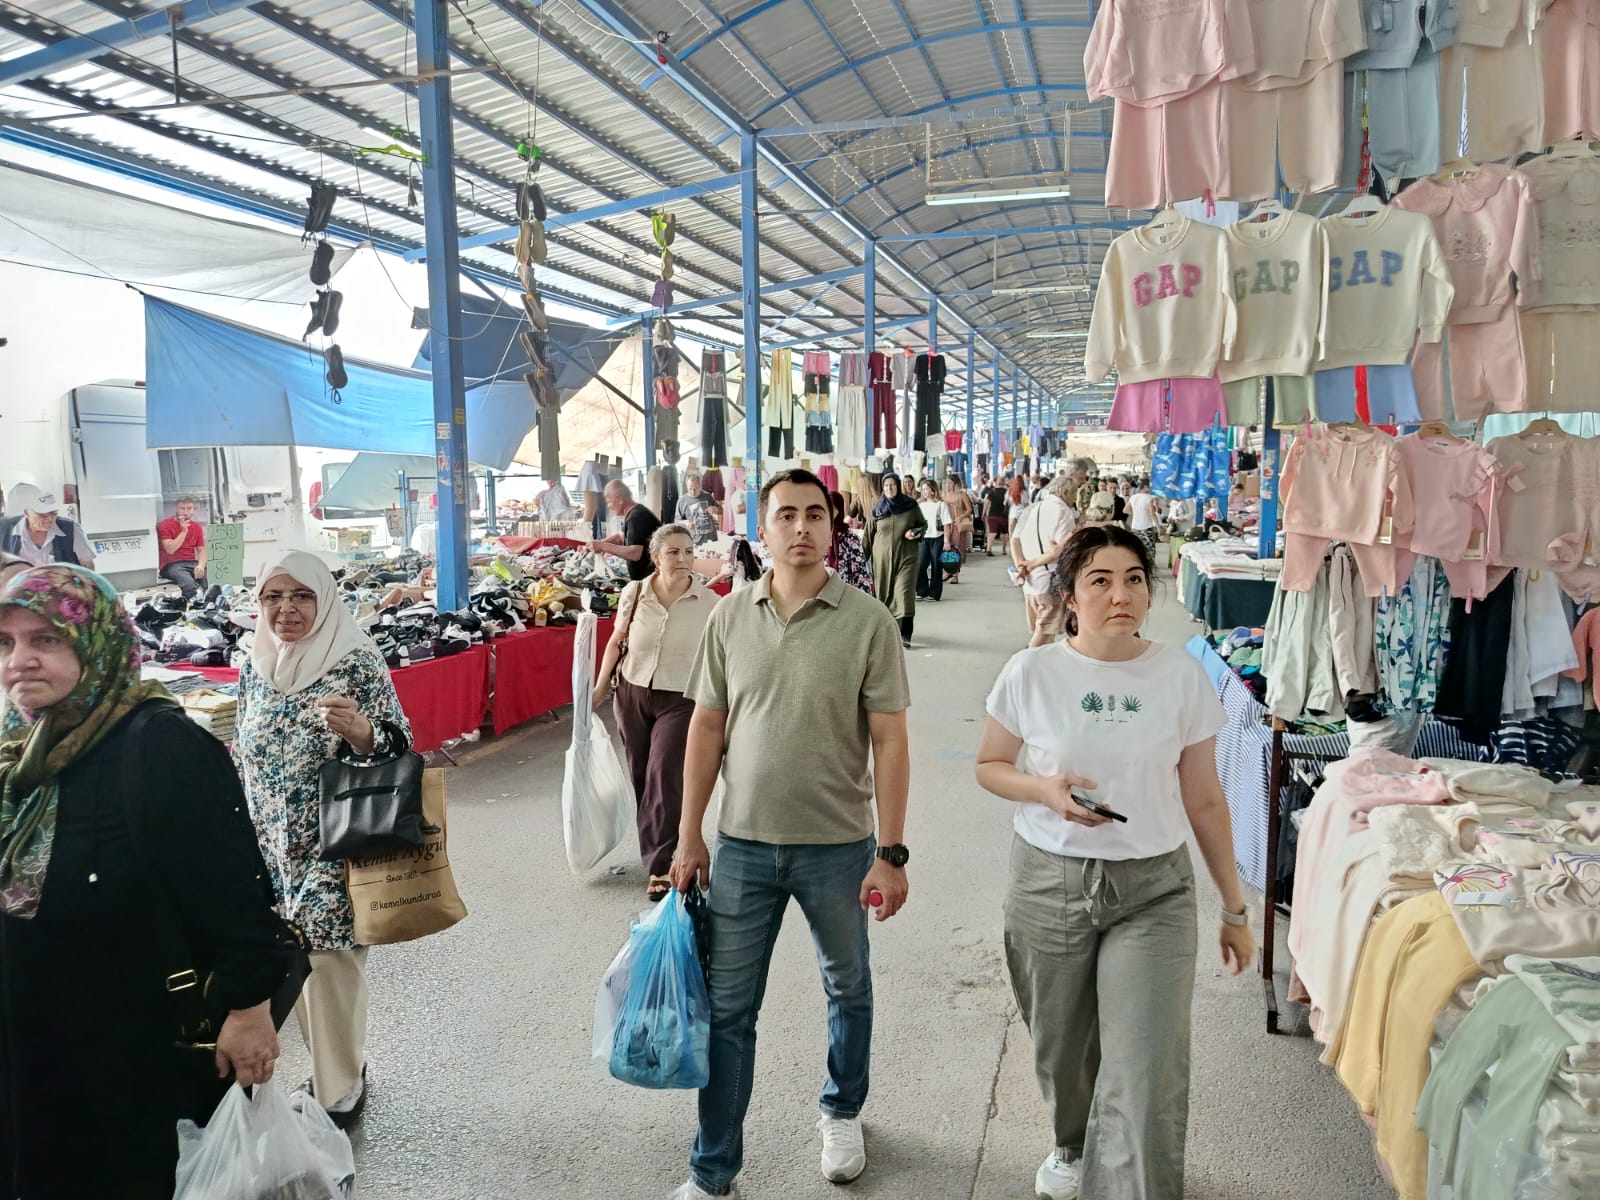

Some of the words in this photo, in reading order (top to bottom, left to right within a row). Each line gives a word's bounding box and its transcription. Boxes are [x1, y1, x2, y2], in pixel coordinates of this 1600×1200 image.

[1133, 263, 1203, 308] GAP
[1233, 259, 1300, 303] GAP
[1329, 250, 1404, 293] GAP
[1075, 418, 1102, 426] ULUS
